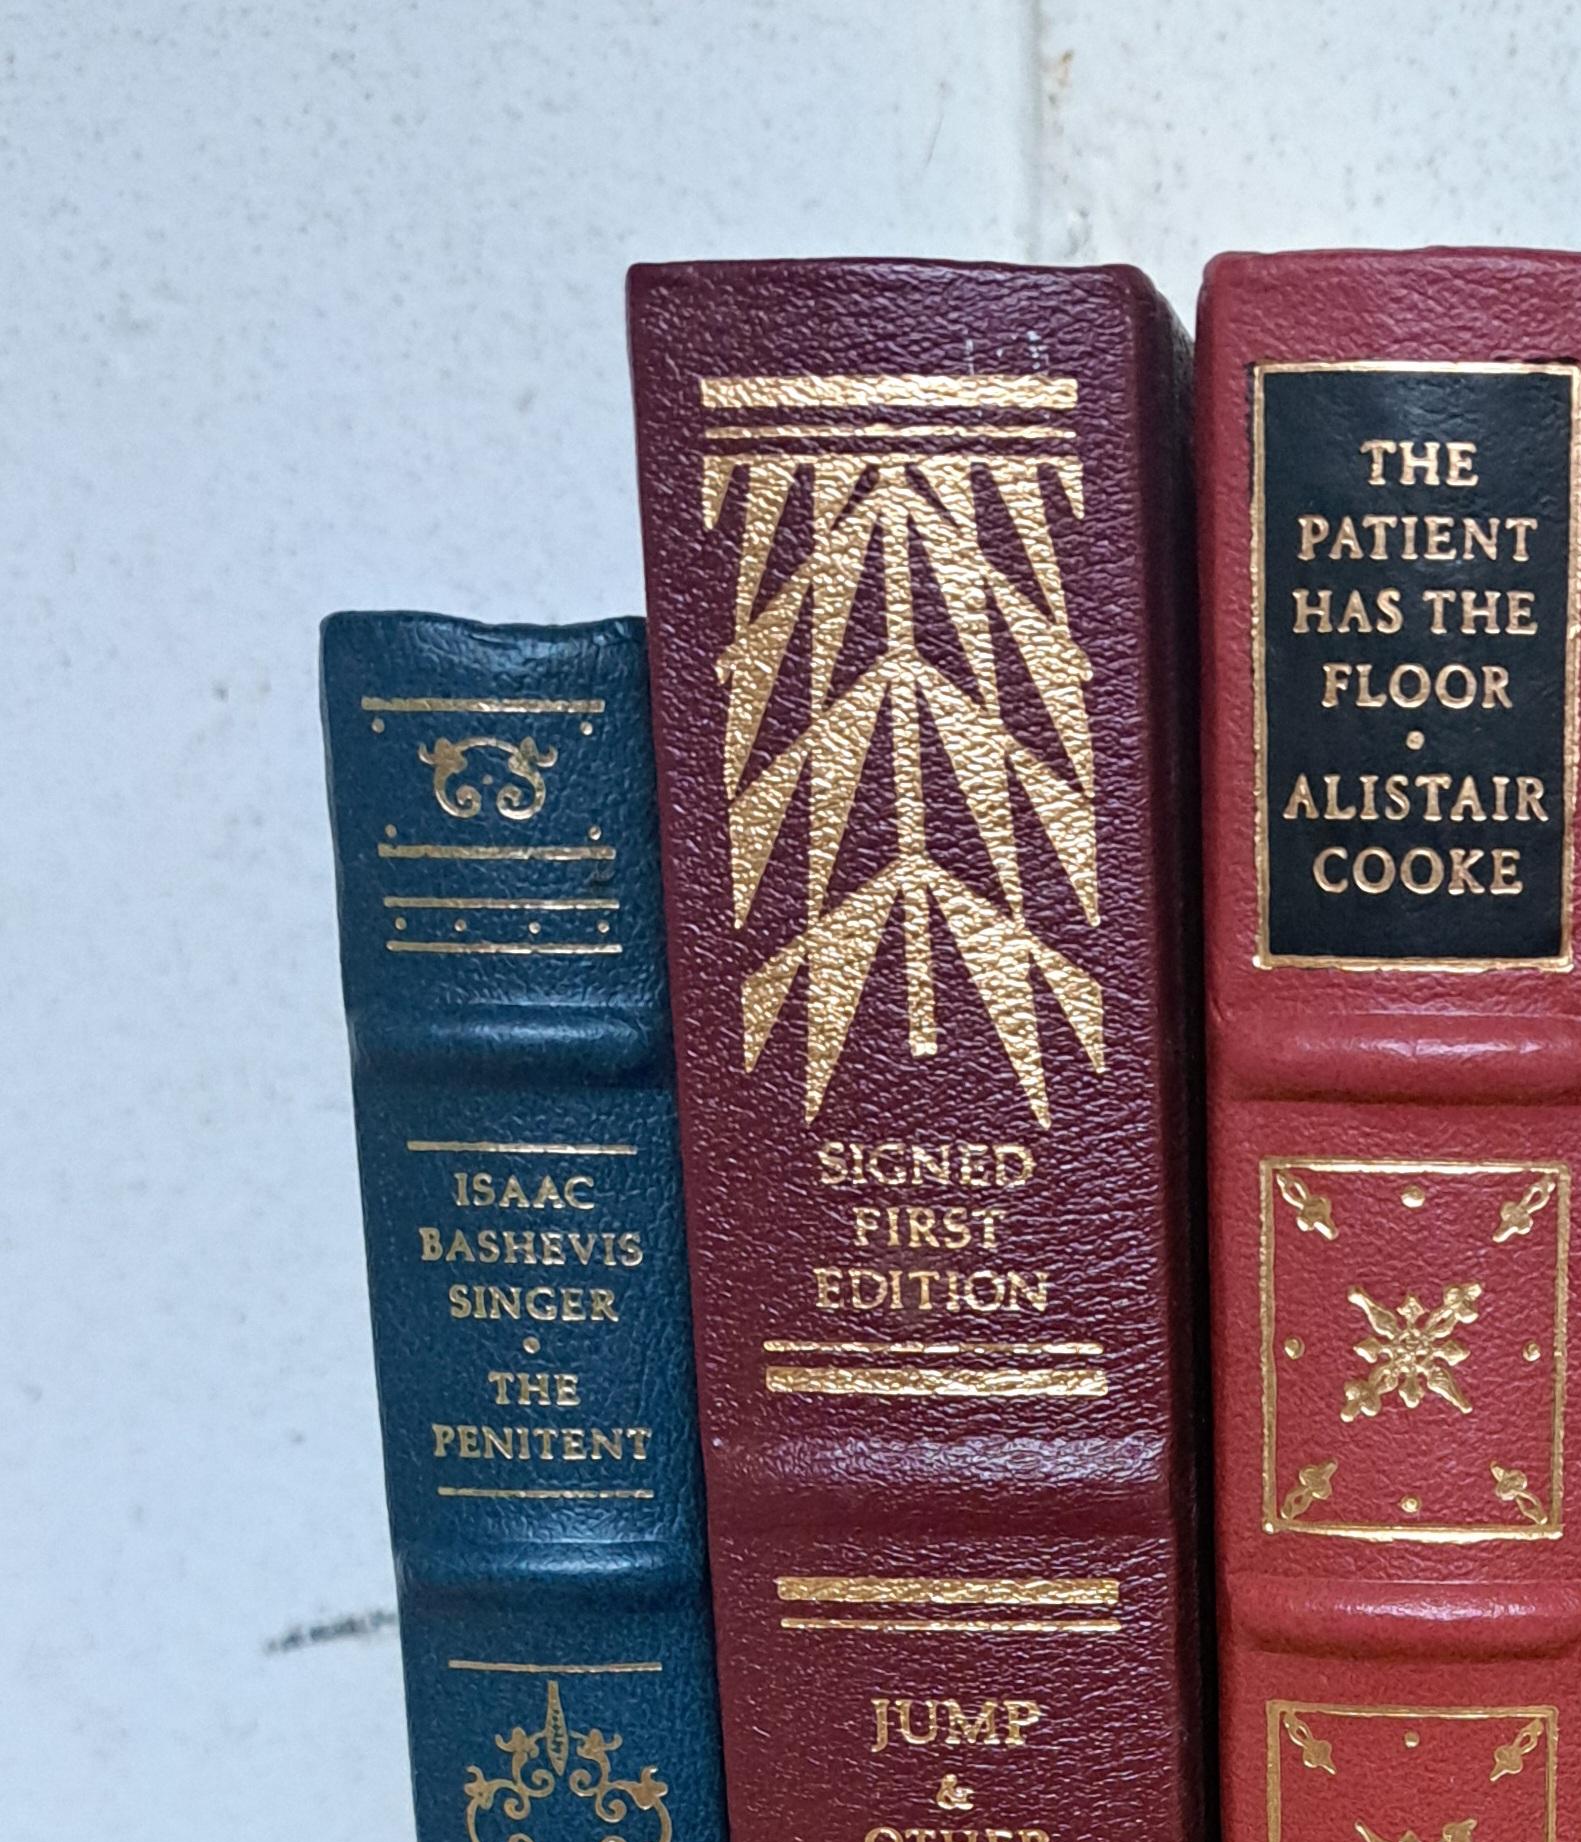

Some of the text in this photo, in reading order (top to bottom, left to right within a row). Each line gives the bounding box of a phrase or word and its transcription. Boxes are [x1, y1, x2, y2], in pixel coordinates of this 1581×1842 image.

[1361, 440, 1479, 487] THE
[1297, 514, 1538, 562] PATIENT
[1292, 589, 1538, 635] HAS THE
[1321, 664, 1512, 709] FLOOR
[1283, 773, 1549, 822] ALISTAIR
[1312, 847, 1523, 895] COOKE
[816, 1141, 1037, 1187] SIGNED
[453, 1173, 595, 1210] ISAAC
[418, 1227, 644, 1267] BASHEVIS
[852, 1206, 1007, 1250] FIRST
[448, 1284, 619, 1322] SINGER
[812, 1266, 1049, 1313] EDITION
[487, 1371, 581, 1406] THE
[431, 1423, 652, 1460] PENITENT
[870, 1699, 1042, 1753] JUMP
[936, 1773, 975, 1810] &
